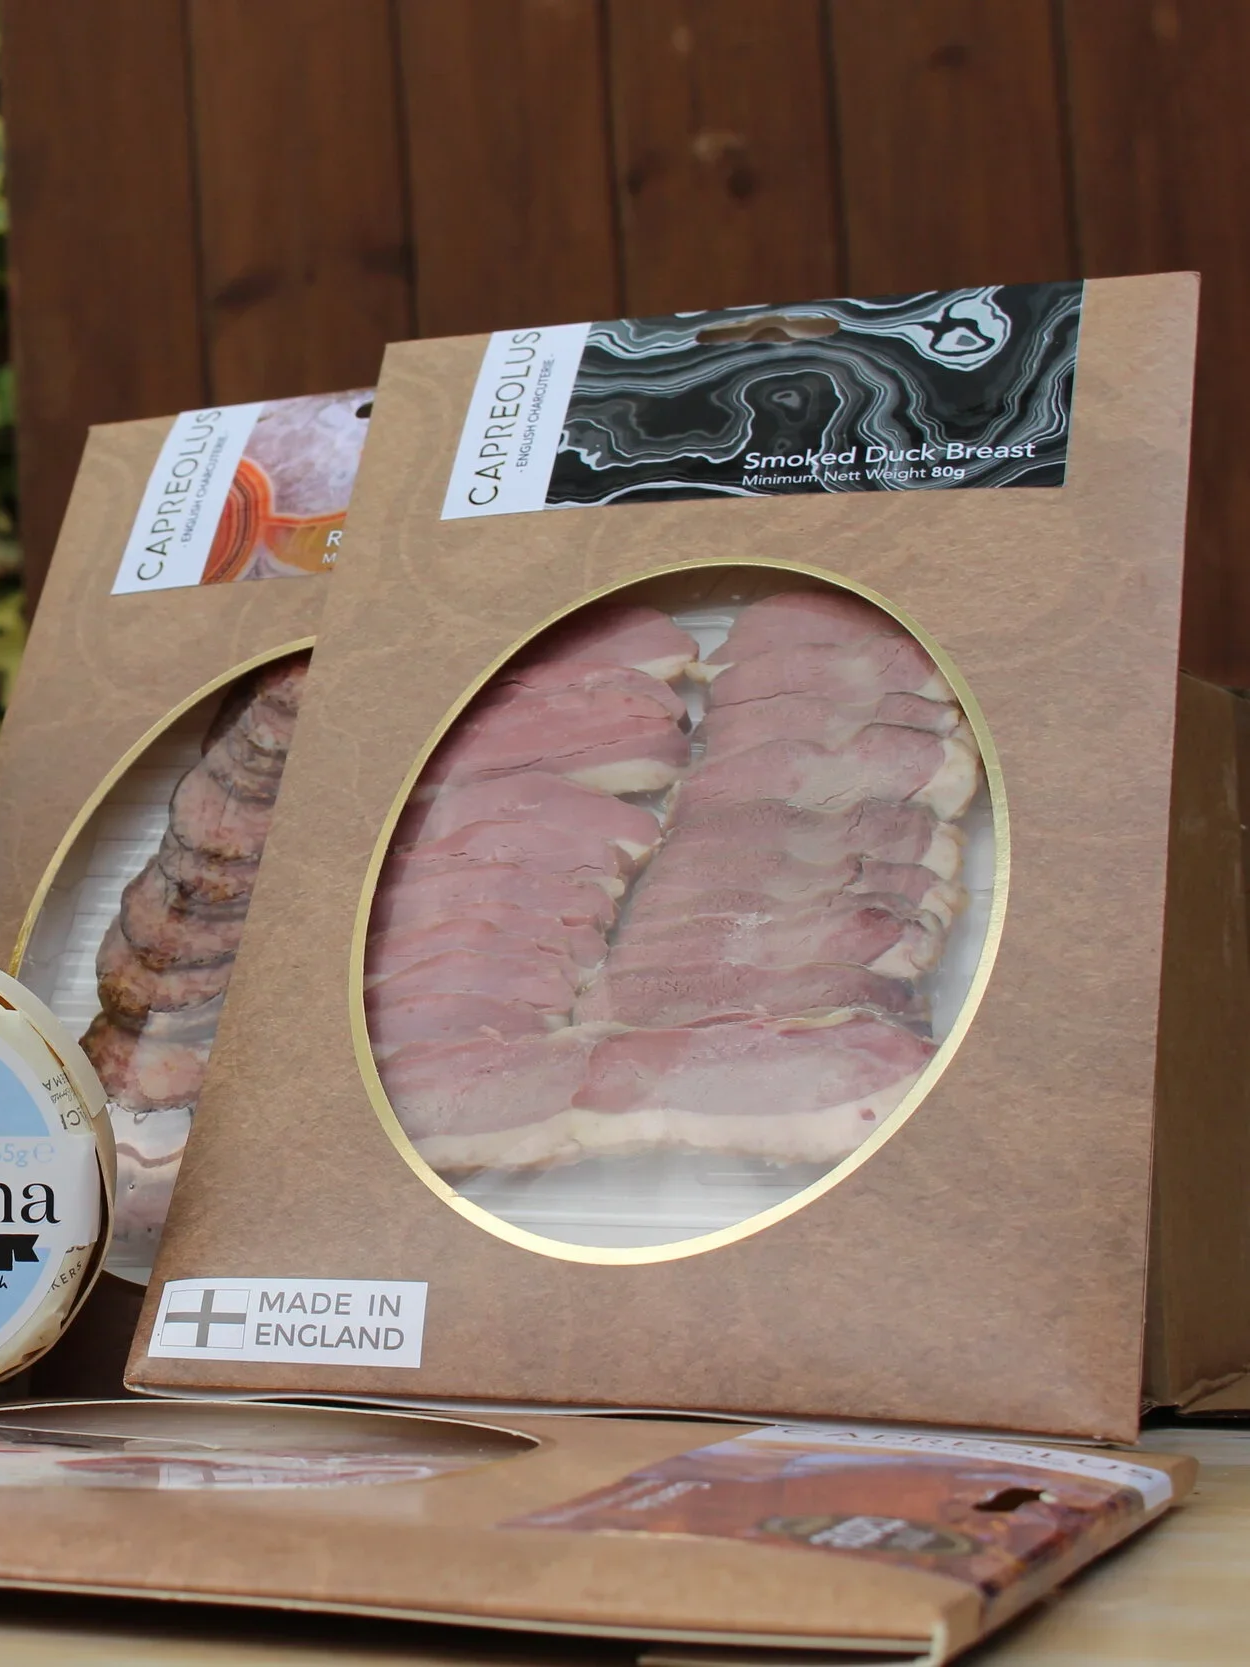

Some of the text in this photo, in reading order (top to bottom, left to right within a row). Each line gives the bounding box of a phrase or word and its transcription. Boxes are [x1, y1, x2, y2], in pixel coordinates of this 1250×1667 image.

[468, 331, 541, 505] CAPREOLUS
[516, 358, 555, 468] ENGLISH CHARCUTERIE
[743, 442, 1036, 470] Smoked Duck Breast
[742, 466, 966, 487] Minimum Nett Weight 80g
[137, 410, 222, 581] CAPREOLUS
[259, 1291, 402, 1317] MADE IN
[255, 1323, 405, 1350] ENGLAND
